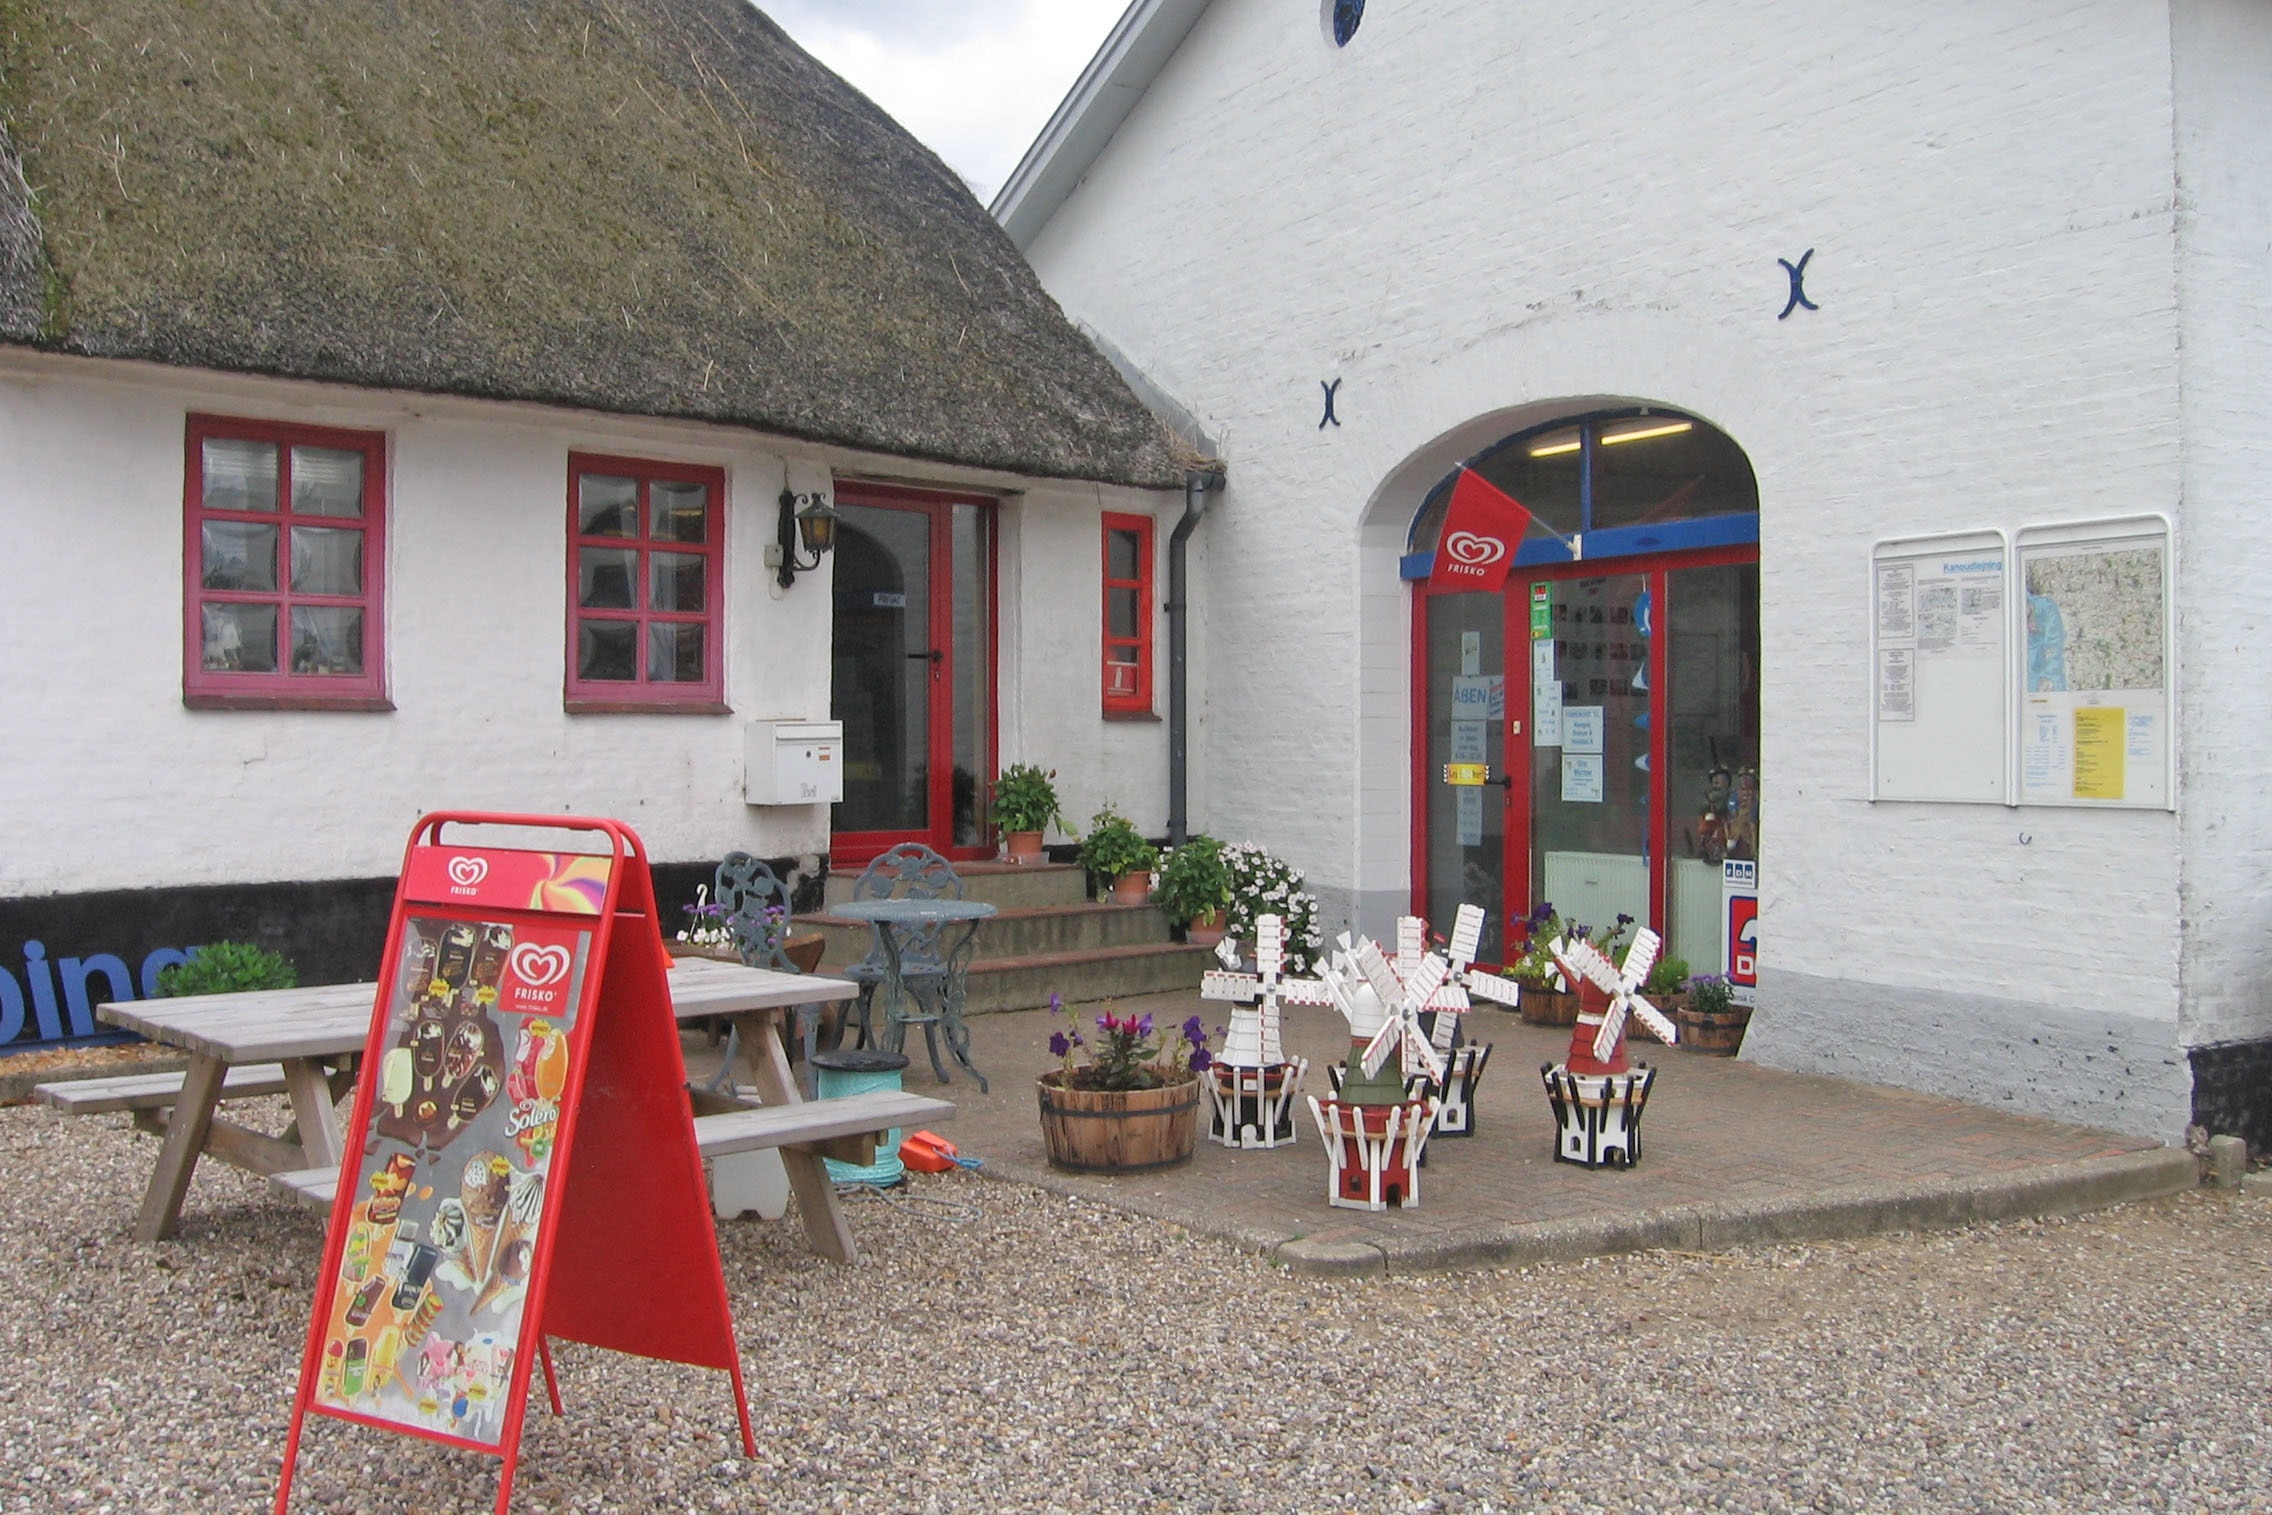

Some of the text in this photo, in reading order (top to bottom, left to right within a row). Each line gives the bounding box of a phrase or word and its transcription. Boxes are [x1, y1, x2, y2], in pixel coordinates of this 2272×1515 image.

[1447, 563, 1485, 577] FRISKO
[514, 987, 554, 1003] FRISKO
[504, 1108, 557, 1138] Solero
